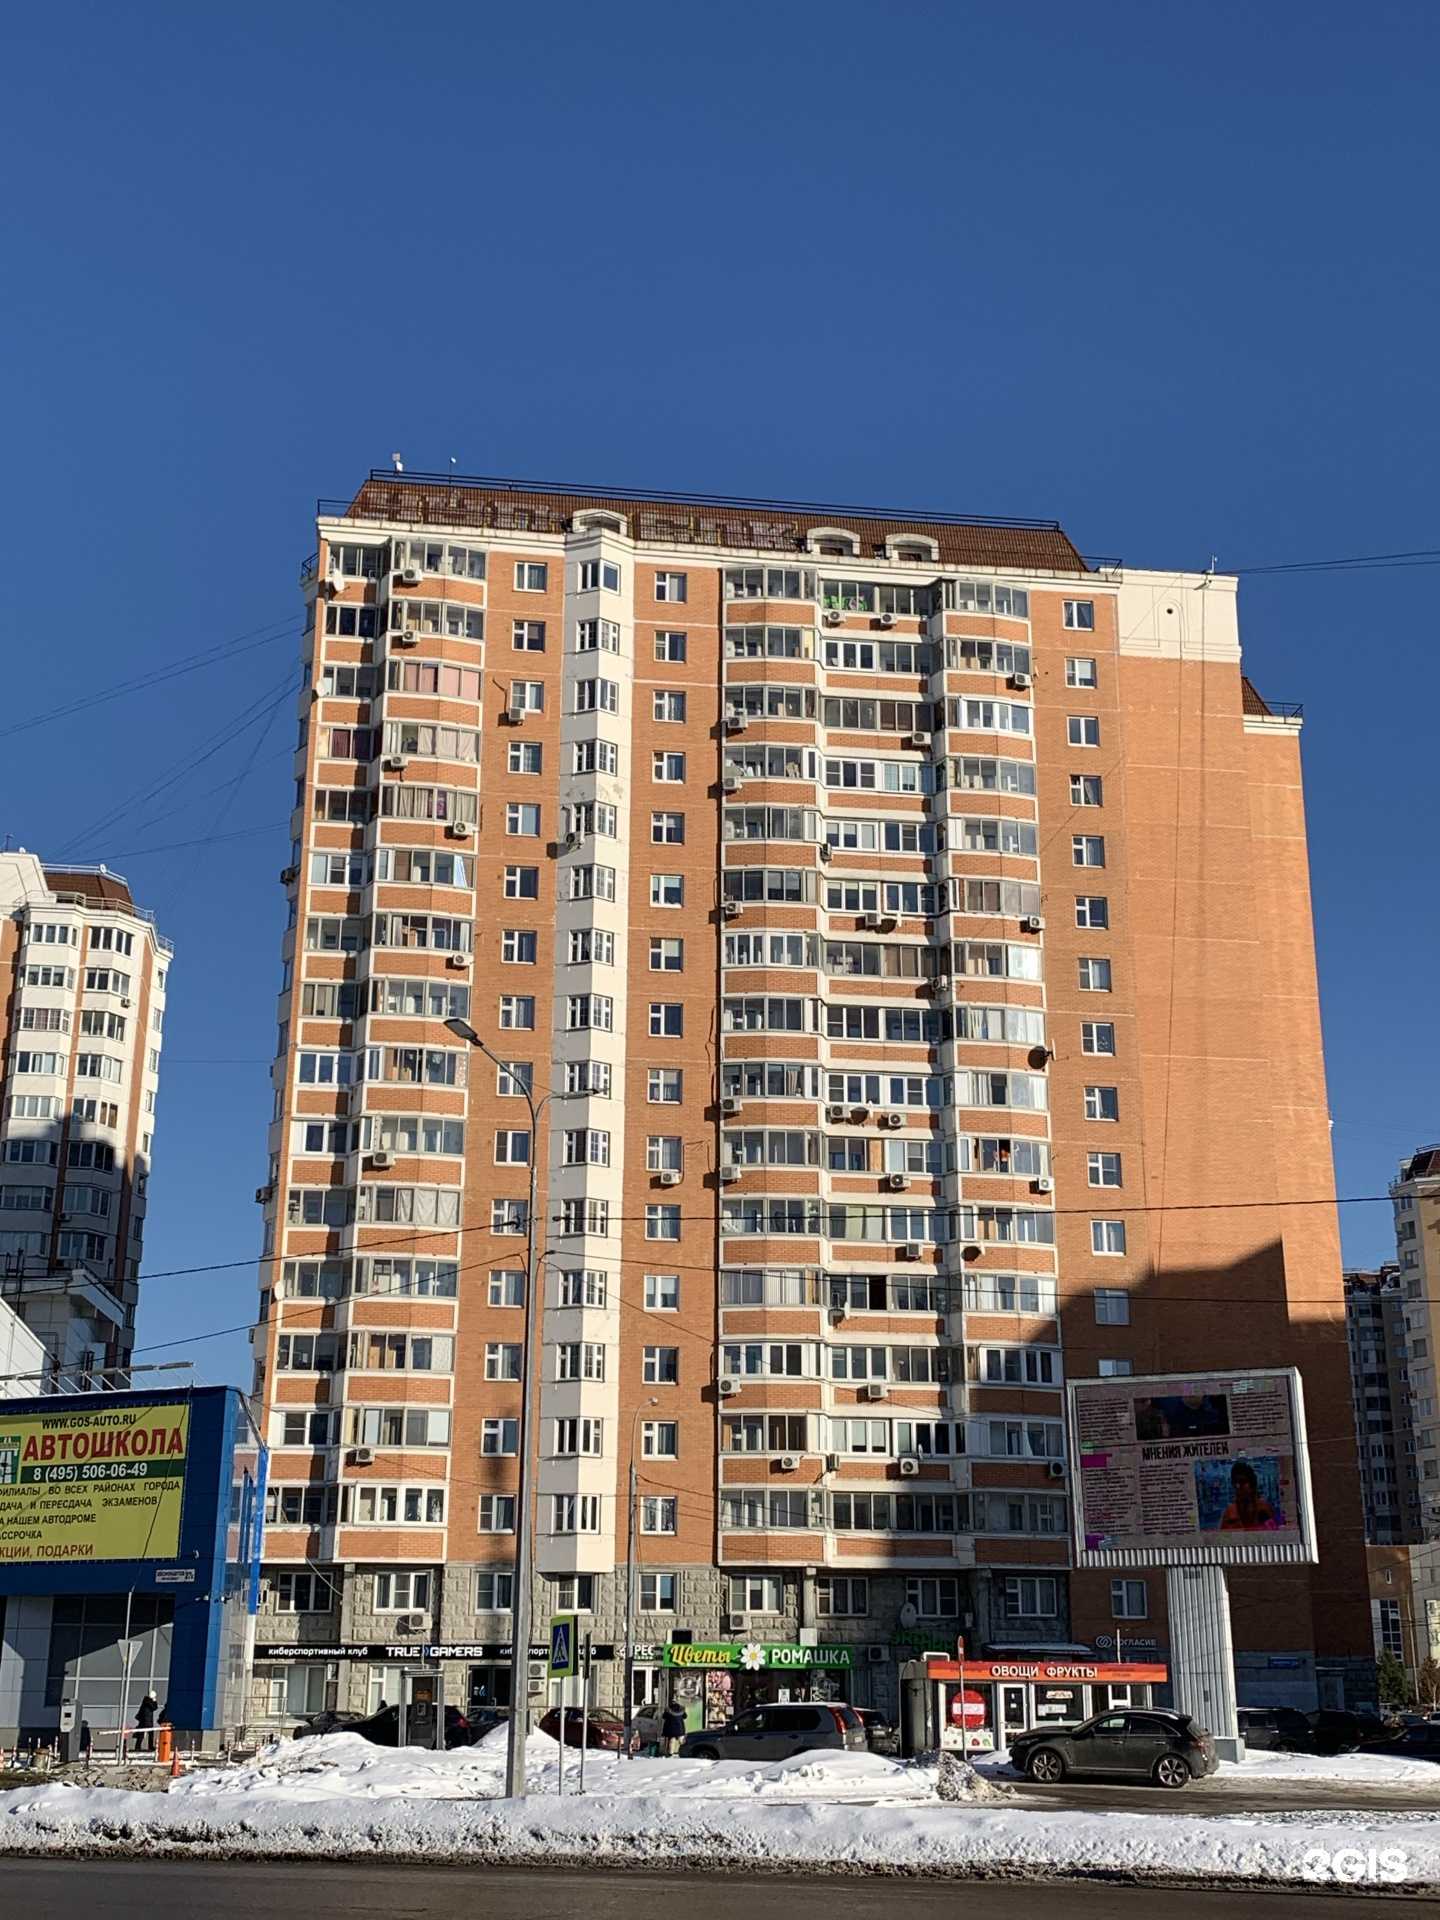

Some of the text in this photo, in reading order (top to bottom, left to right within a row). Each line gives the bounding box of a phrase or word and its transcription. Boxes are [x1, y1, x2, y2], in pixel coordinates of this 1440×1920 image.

[42, 1414, 136, 1429] WWW.GOS-AUTO.RU
[22, 1427, 184, 1461] АВТОШКОЛА
[1142, 1444, 1181, 1461] МНЕНИЯ
[33, 1462, 147, 1483] 8 (495) 506-06-49
[48, 1485, 61, 1495] ВО
[64, 1484, 87, 1494] ВСЕХ
[93, 1482, 135, 1492] РАЙОНАХ
[144, 1480, 180, 1491] ГОРОДА
[30, 1501, 36, 1509] И
[40, 1499, 92, 1510] ПЕРЕСДАЧА
[7, 1515, 40, 1525] НАШЕМ
[42, 1513, 96, 1525] АВТОДРОМЕ
[0, 1530, 42, 1540] ССРОЧКА
[37, 1543, 93, 1558] ПОДАРКИ
[268, 1646, 368, 1656] киберспортивный клуб
[385, 1646, 483, 1657] TRUE GAMERS
[670, 1644, 731, 1665] Цветы
[771, 1648, 850, 1664] РОМАШКА
[991, 1665, 1039, 1678] ОВОЩИ
[1046, 1666, 1098, 1678] ФРУКТЫ
